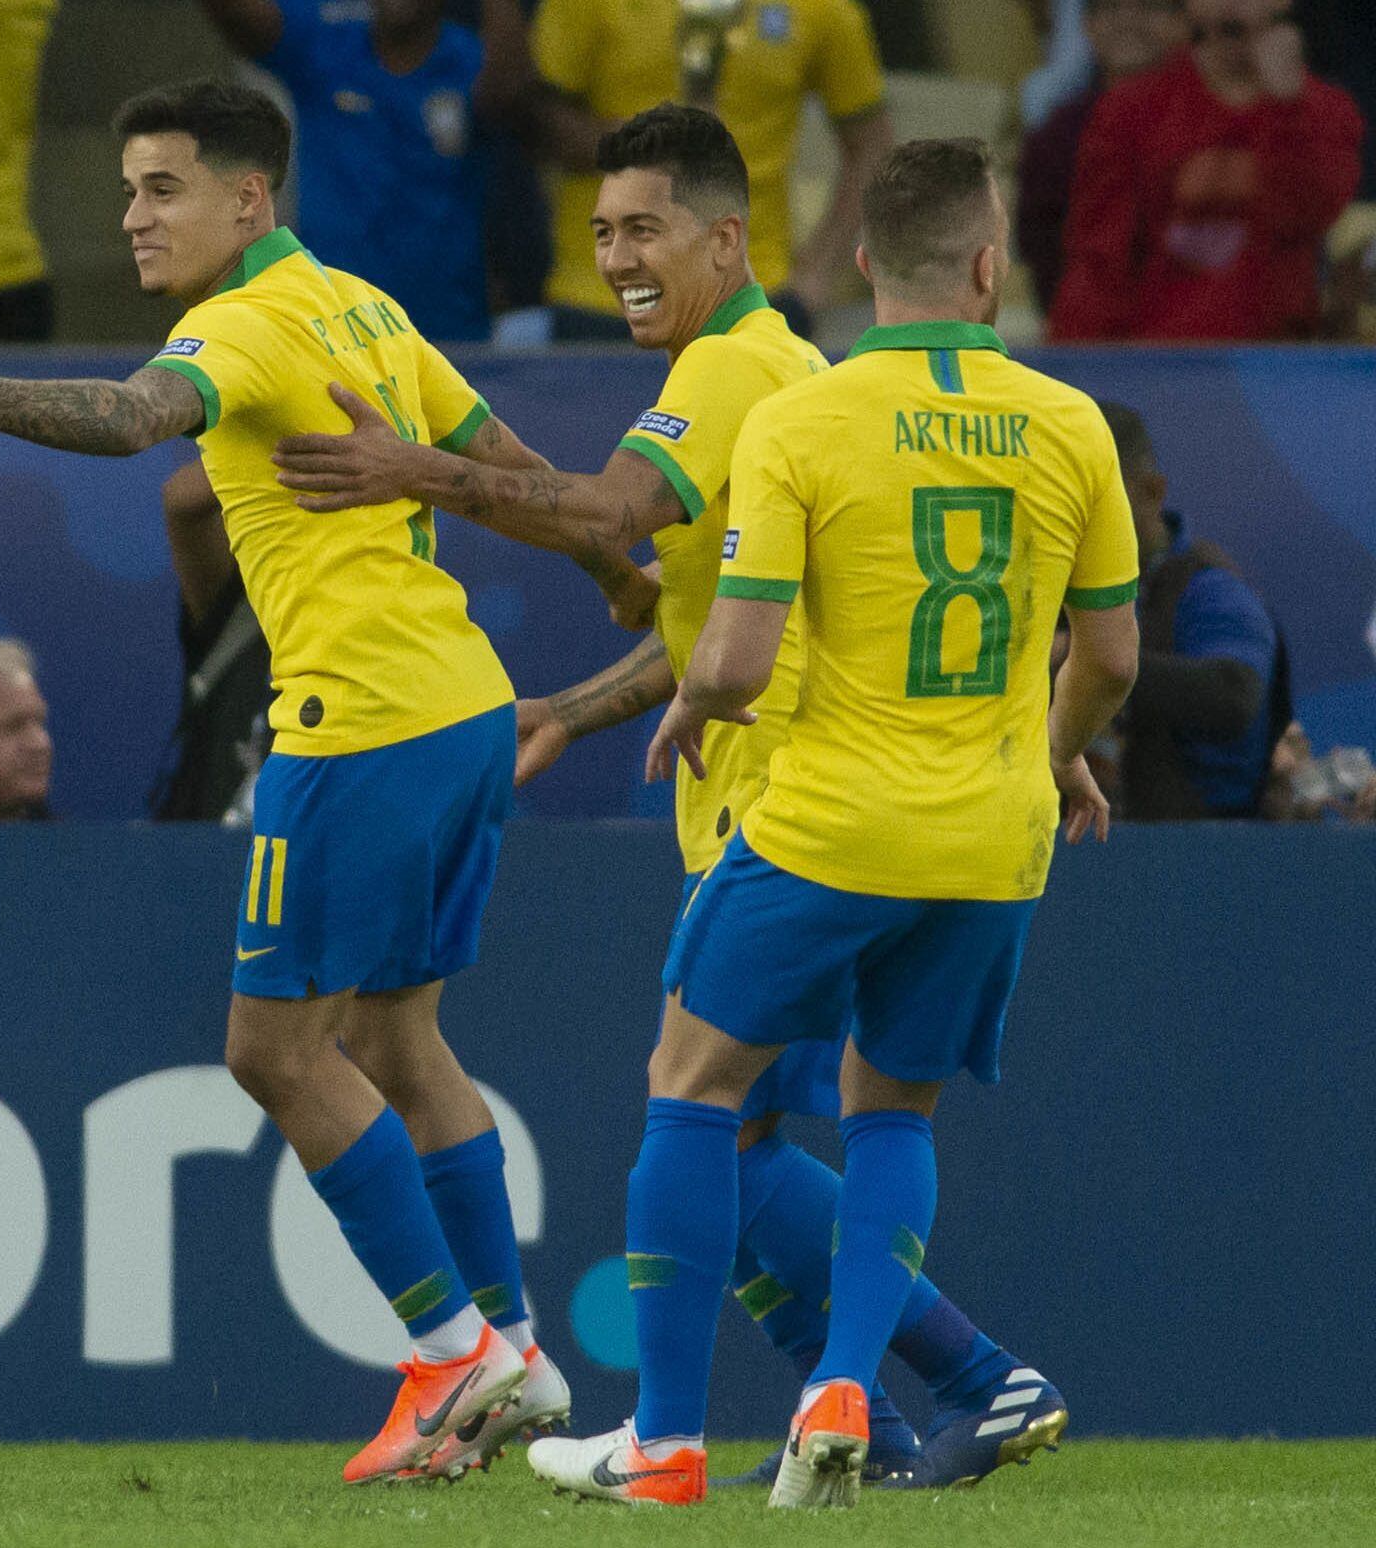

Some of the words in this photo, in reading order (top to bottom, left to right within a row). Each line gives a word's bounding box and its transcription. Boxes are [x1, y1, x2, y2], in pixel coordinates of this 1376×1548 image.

[640, 412, 668, 423] Cree
[668, 419, 685, 430] en
[895, 410, 1030, 457] ARTHUR
[905, 486, 1015, 698] 8
[246, 834, 288, 927] 11
